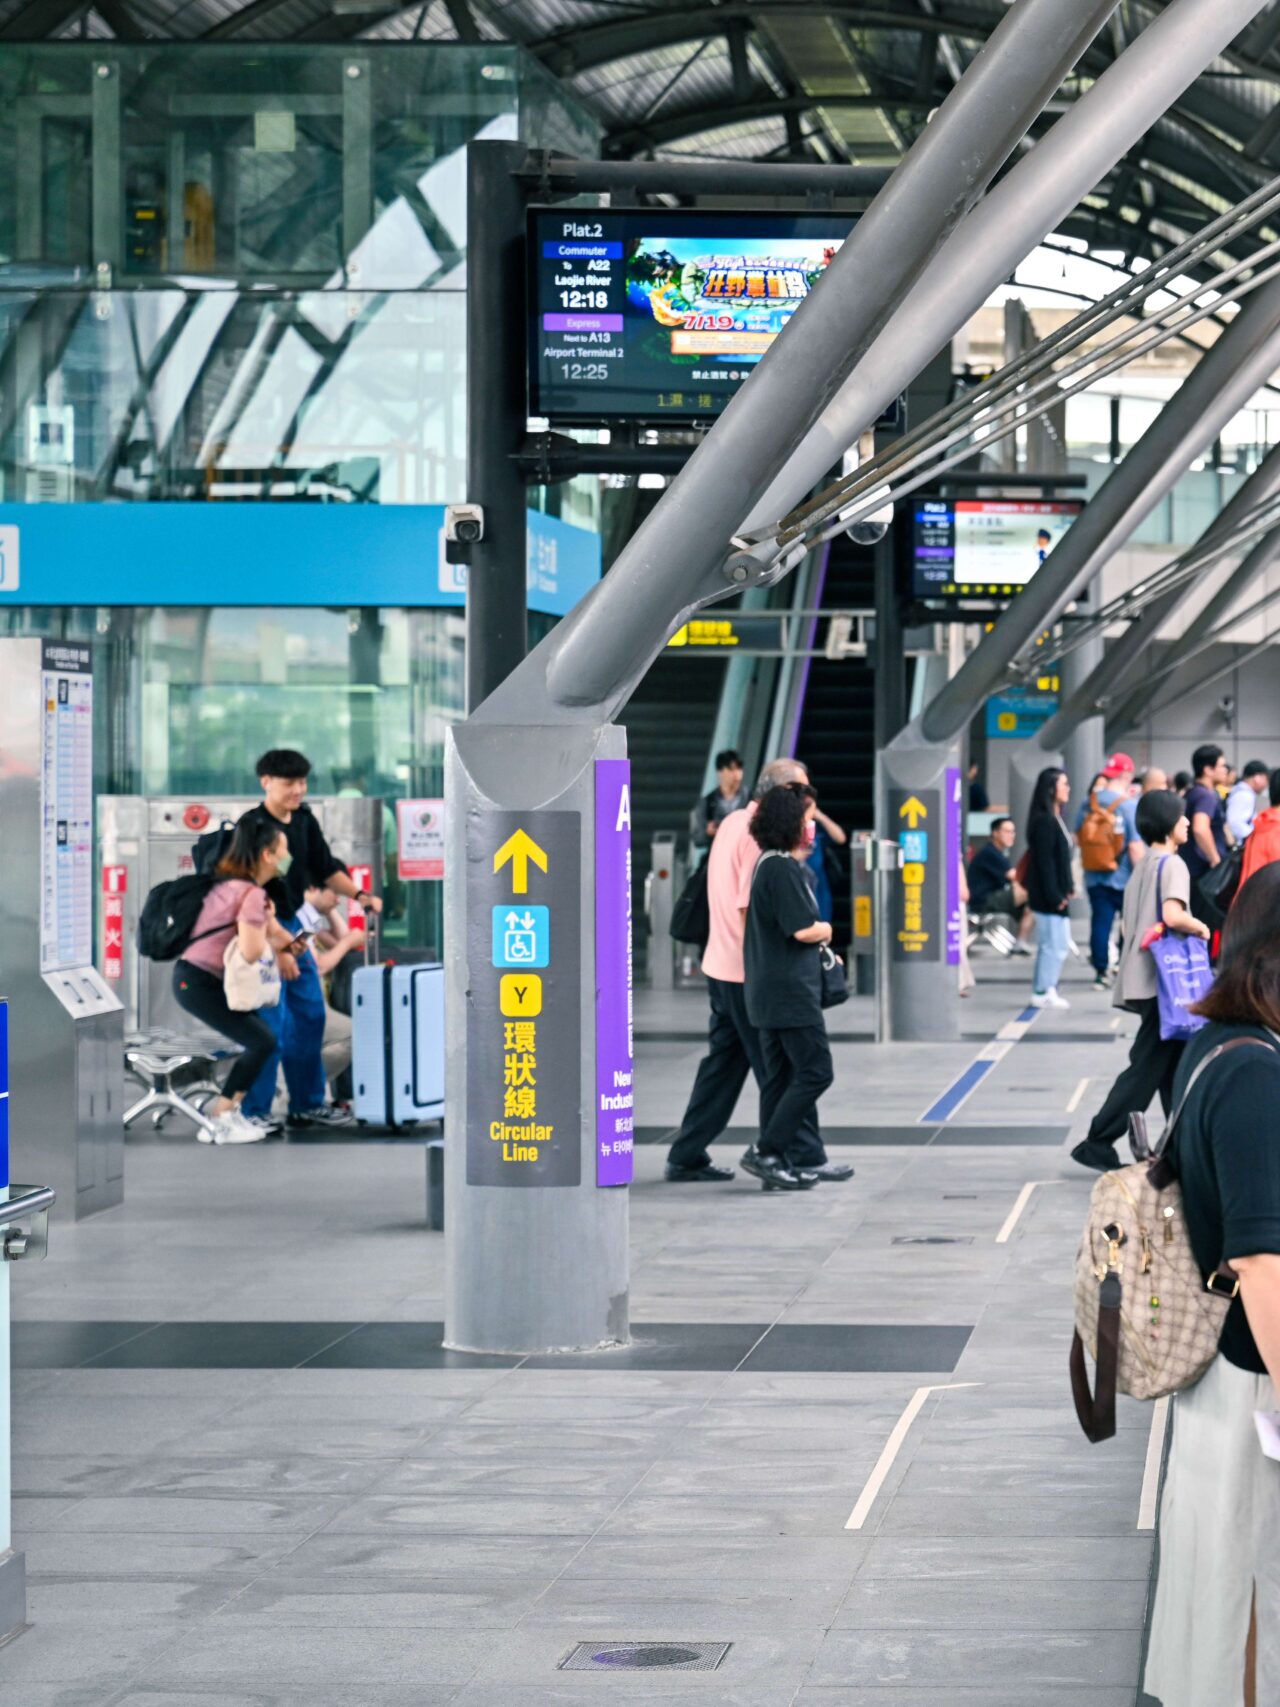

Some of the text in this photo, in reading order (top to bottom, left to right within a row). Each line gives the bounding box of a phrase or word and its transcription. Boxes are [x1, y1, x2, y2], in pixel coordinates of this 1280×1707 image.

[563, 222, 602, 237] Plat.2
[558, 245, 607, 256] Commuter
[562, 259, 611, 271] To A22
[555, 274, 612, 288] Laojie River
[560, 290, 608, 308] 12:18
[566, 318, 602, 329] Express
[683, 315, 734, 330] 7/19
[563, 334, 579, 343] Next
[589, 331, 611, 343] A13
[544, 347, 624, 359] Airport Terminal 2
[561, 363, 608, 380] 12:25
[514, 986, 528, 1004] Y
[503, 1021, 536, 1119] 環狀線
[489, 1121, 553, 1141] Circular
[503, 1143, 538, 1161] Line
